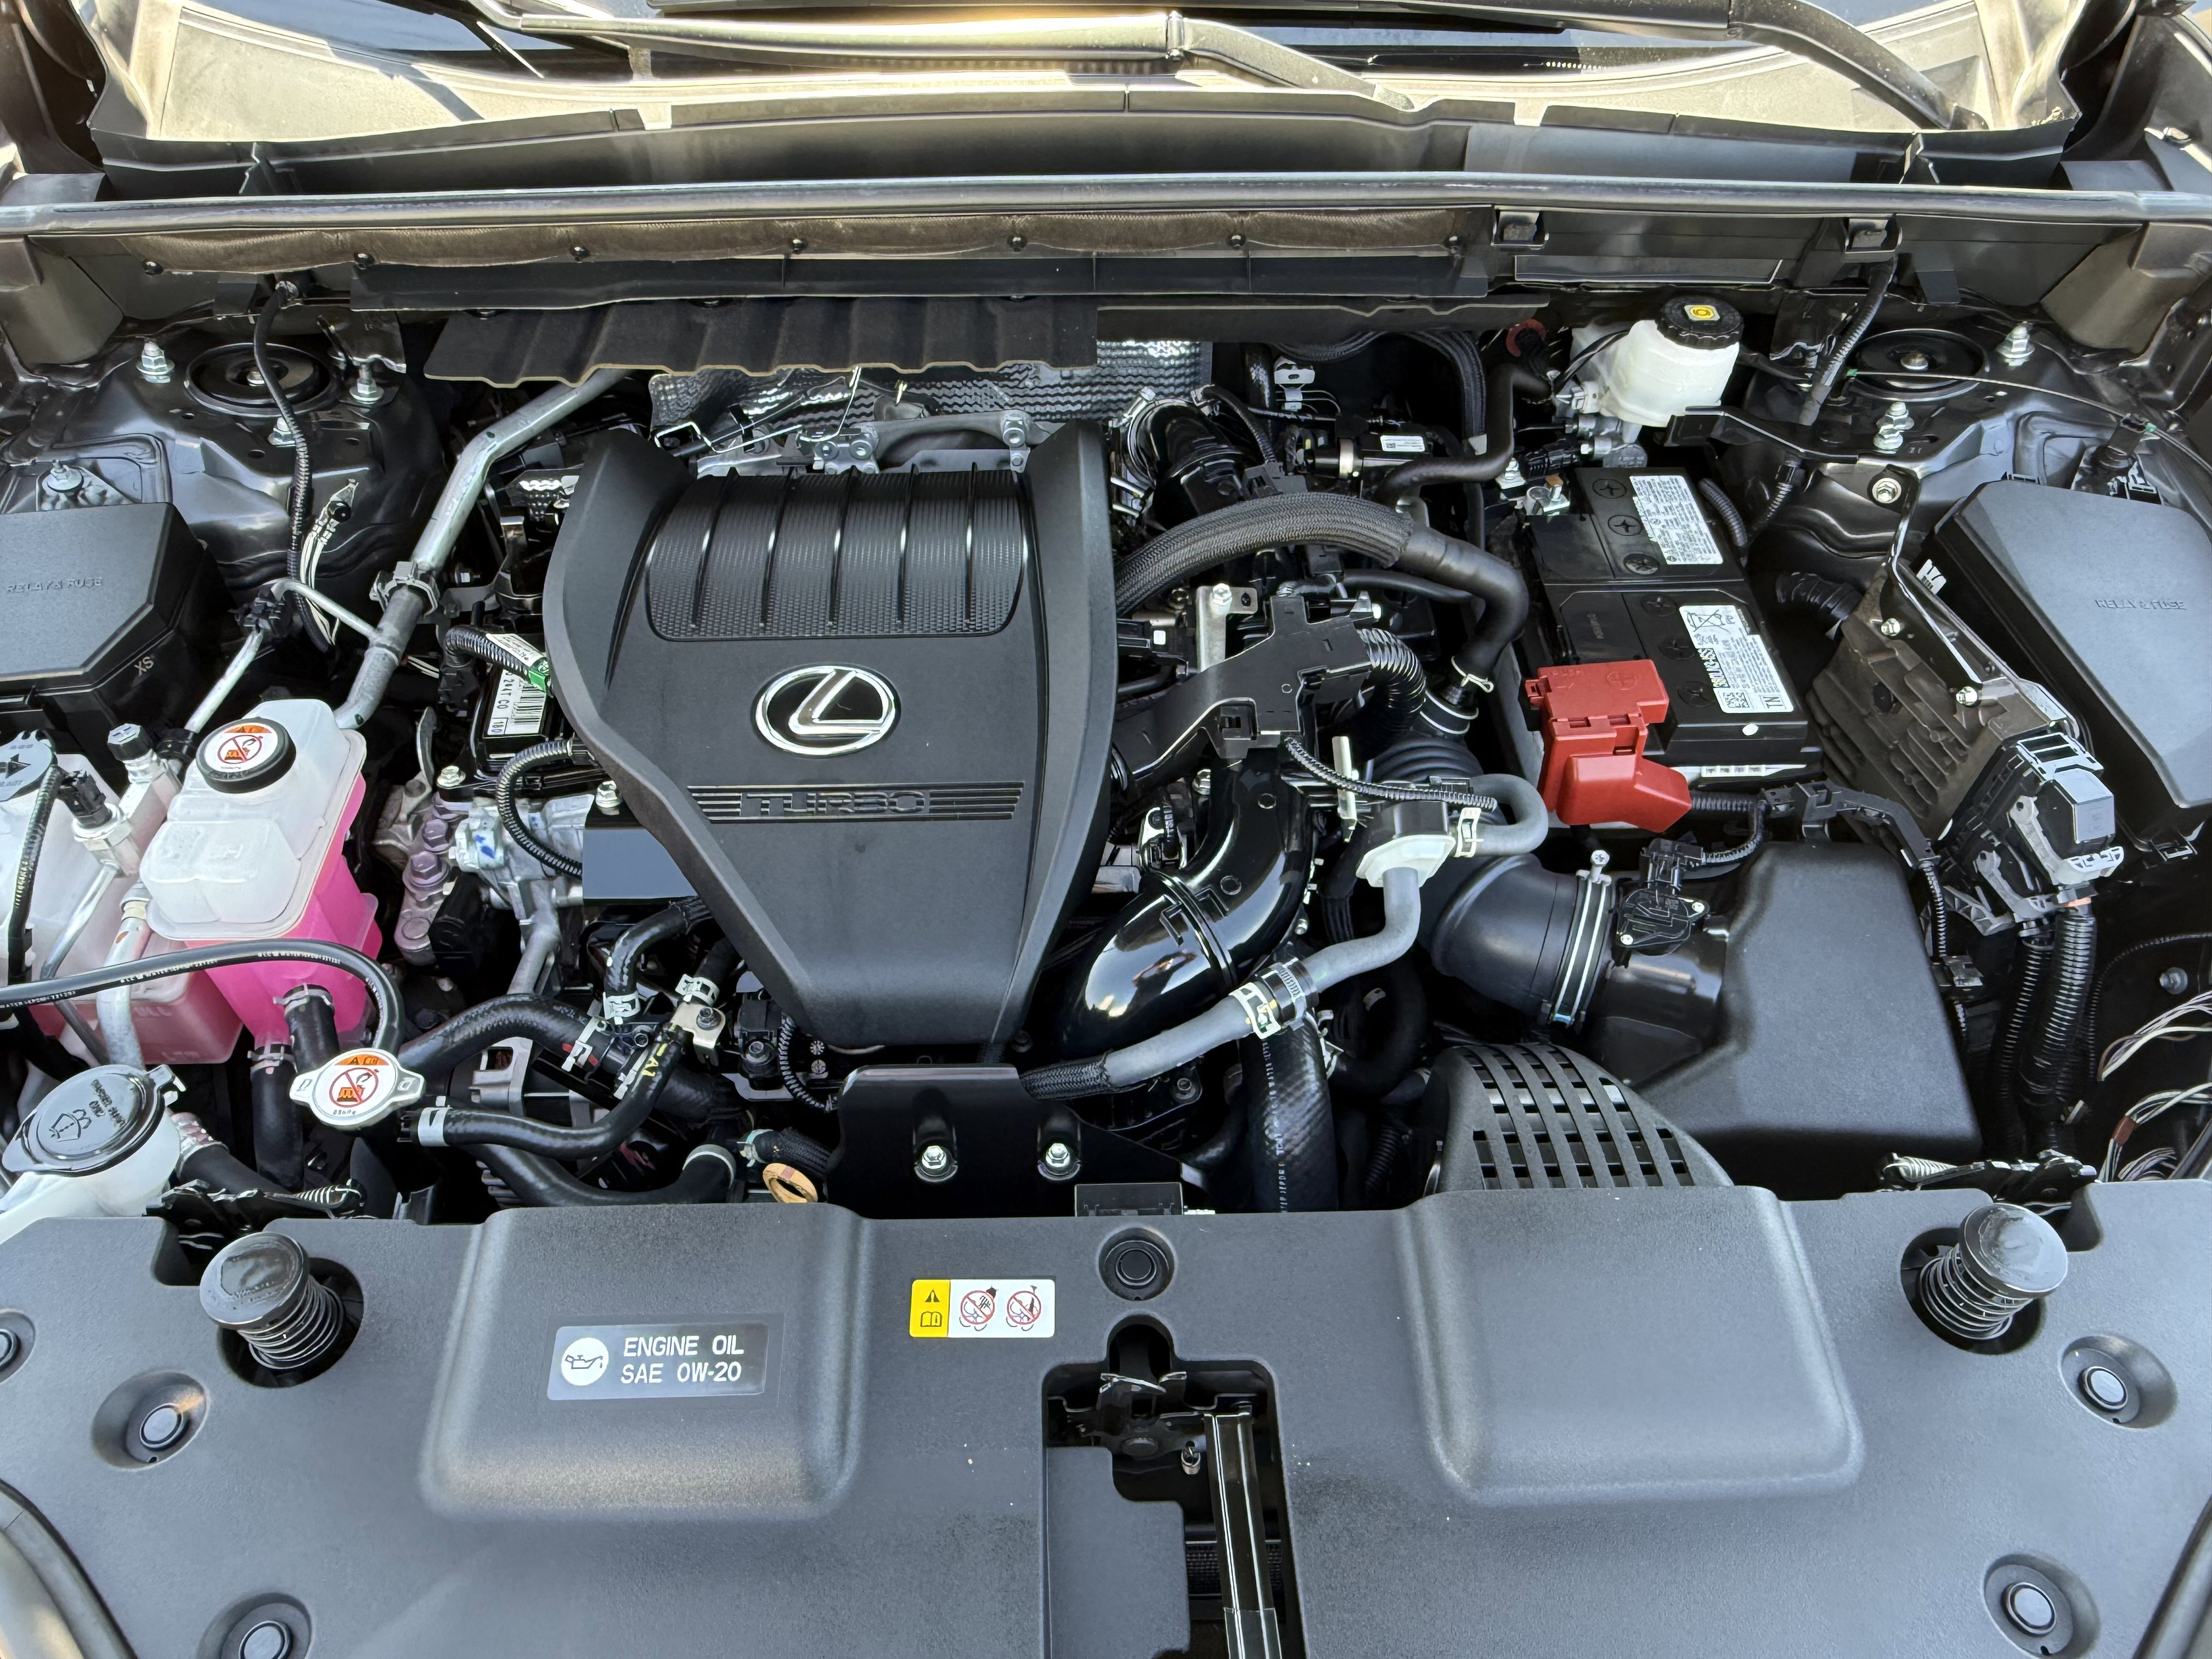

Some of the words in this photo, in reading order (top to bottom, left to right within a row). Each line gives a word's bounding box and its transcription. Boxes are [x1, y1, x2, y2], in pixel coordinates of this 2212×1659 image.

[134, 656, 155, 676] XS
[747, 791, 926, 815] TURBO
[623, 1335, 699, 1357] ENGINE
[712, 1335, 744, 1355] OIL
[620, 1363, 664, 1384] SAE
[676, 1361, 742, 1383] 0W-20
